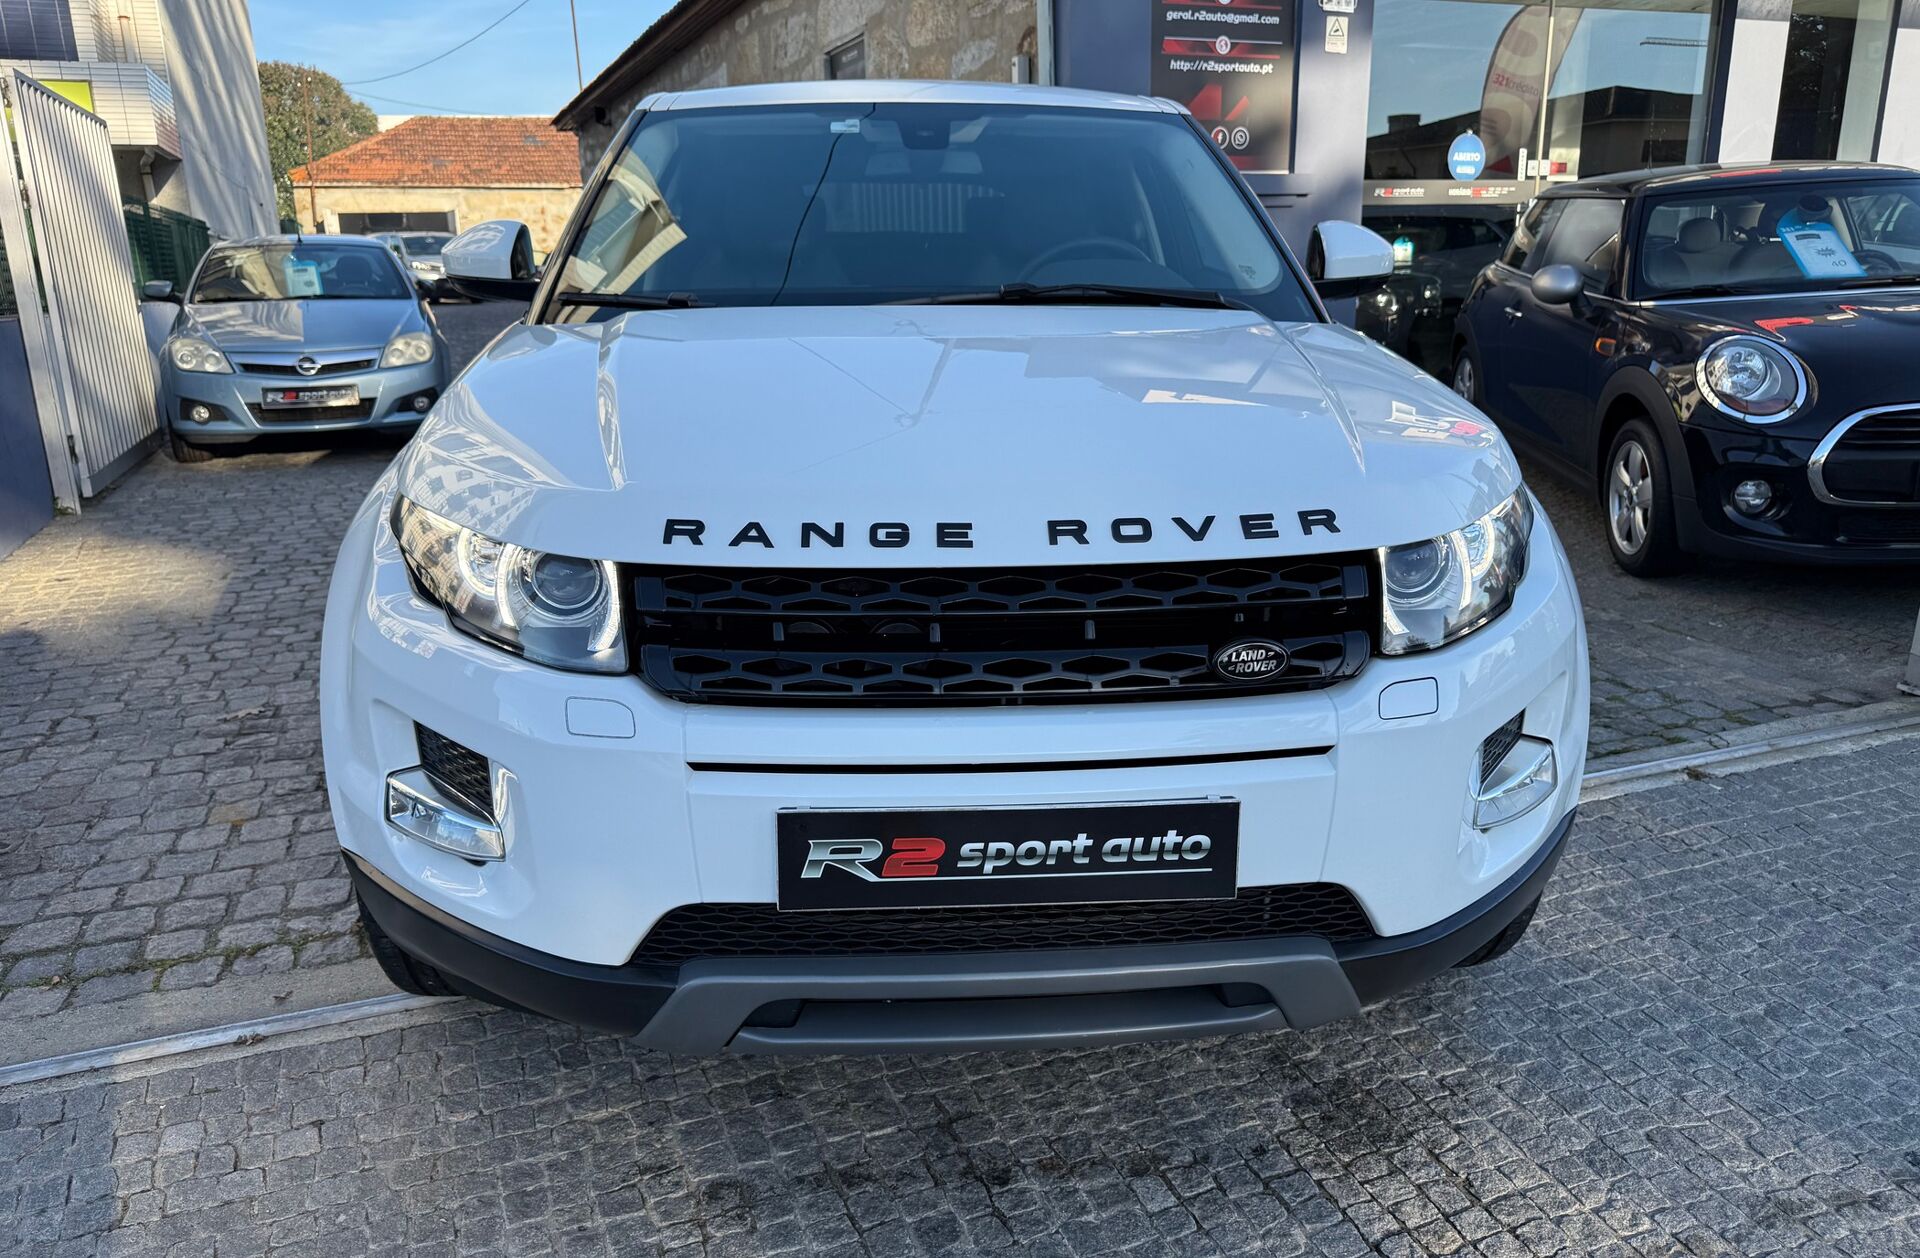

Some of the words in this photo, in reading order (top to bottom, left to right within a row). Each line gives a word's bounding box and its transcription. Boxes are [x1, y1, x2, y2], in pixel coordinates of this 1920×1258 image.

[1166, 10, 1280, 24] geral.r2auto@gmail.com
[1170, 59, 1274, 74] http://r2sportauto.pt
[662, 518, 974, 549] RANGE
[1047, 508, 1341, 546] ROVER
[1231, 649, 1266, 662] LAND
[1235, 660, 1277, 673] ROVER
[800, 838, 946, 882] R2
[956, 833, 1094, 874] sport
[1101, 829, 1211, 863] auto
